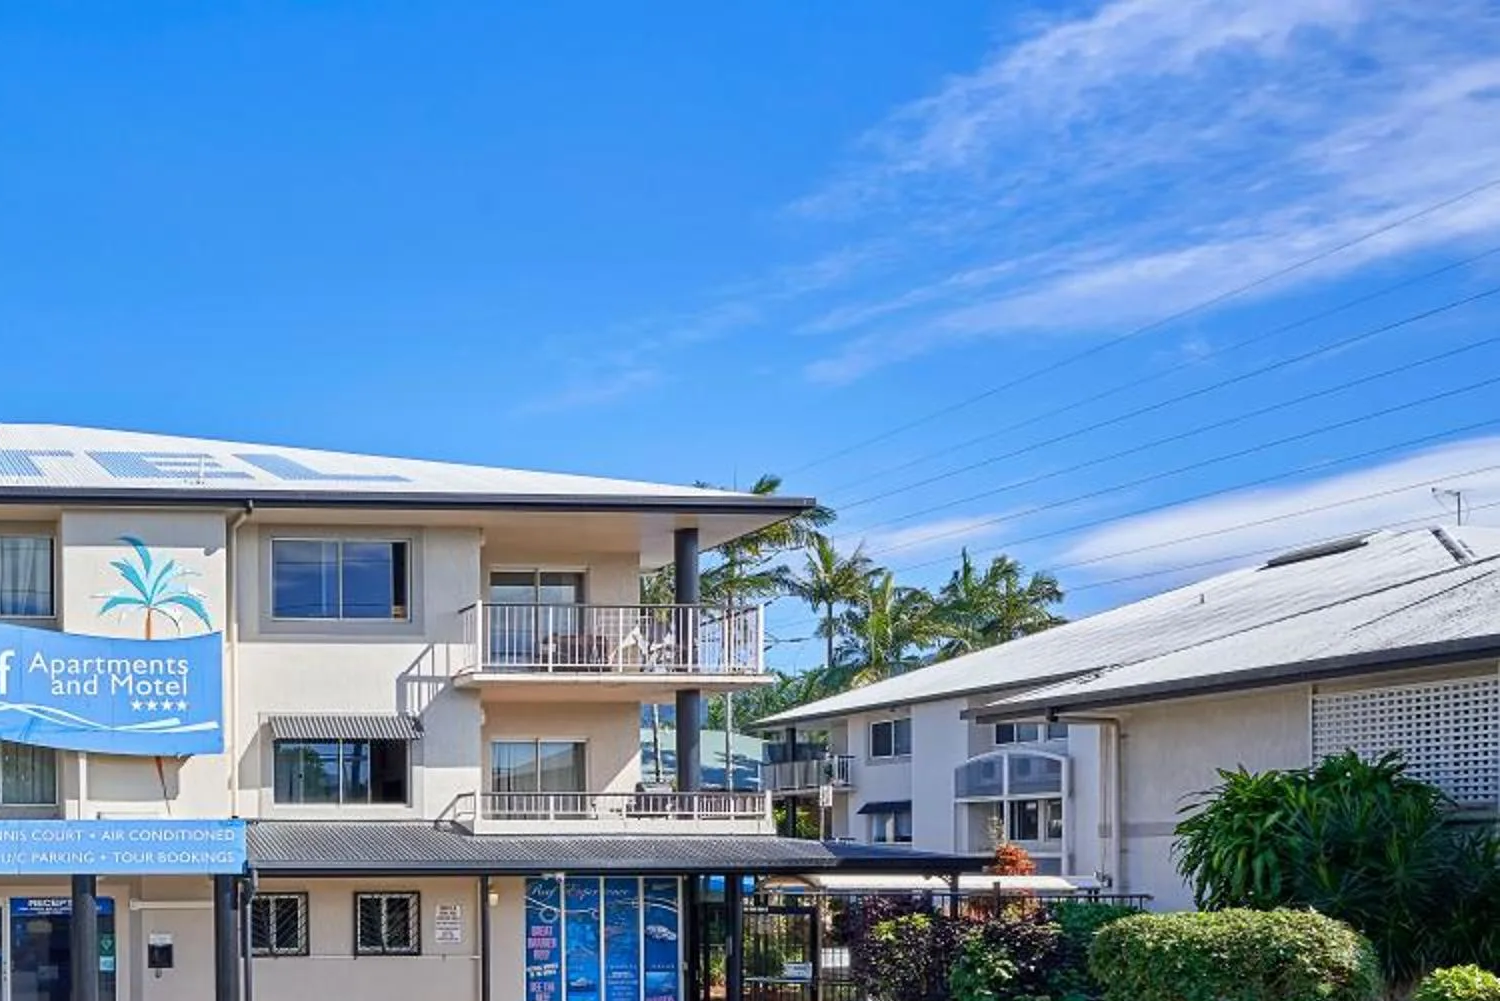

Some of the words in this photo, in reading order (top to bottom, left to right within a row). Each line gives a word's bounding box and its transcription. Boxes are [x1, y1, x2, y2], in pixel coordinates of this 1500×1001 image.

[28, 651, 189, 678] Apartments
[52, 675, 98, 696] and
[110, 672, 189, 696] Motel
[31, 830, 83, 842] COURT
[101, 830, 124, 842] AIR
[128, 830, 235, 842] CONDITIONED
[1, 851, 26, 865] U/C
[31, 851, 95, 864] PARKING
[112, 851, 154, 864] TOUR
[158, 851, 235, 864] BOOKINGS
[28, 899, 73, 908] RECEPT
